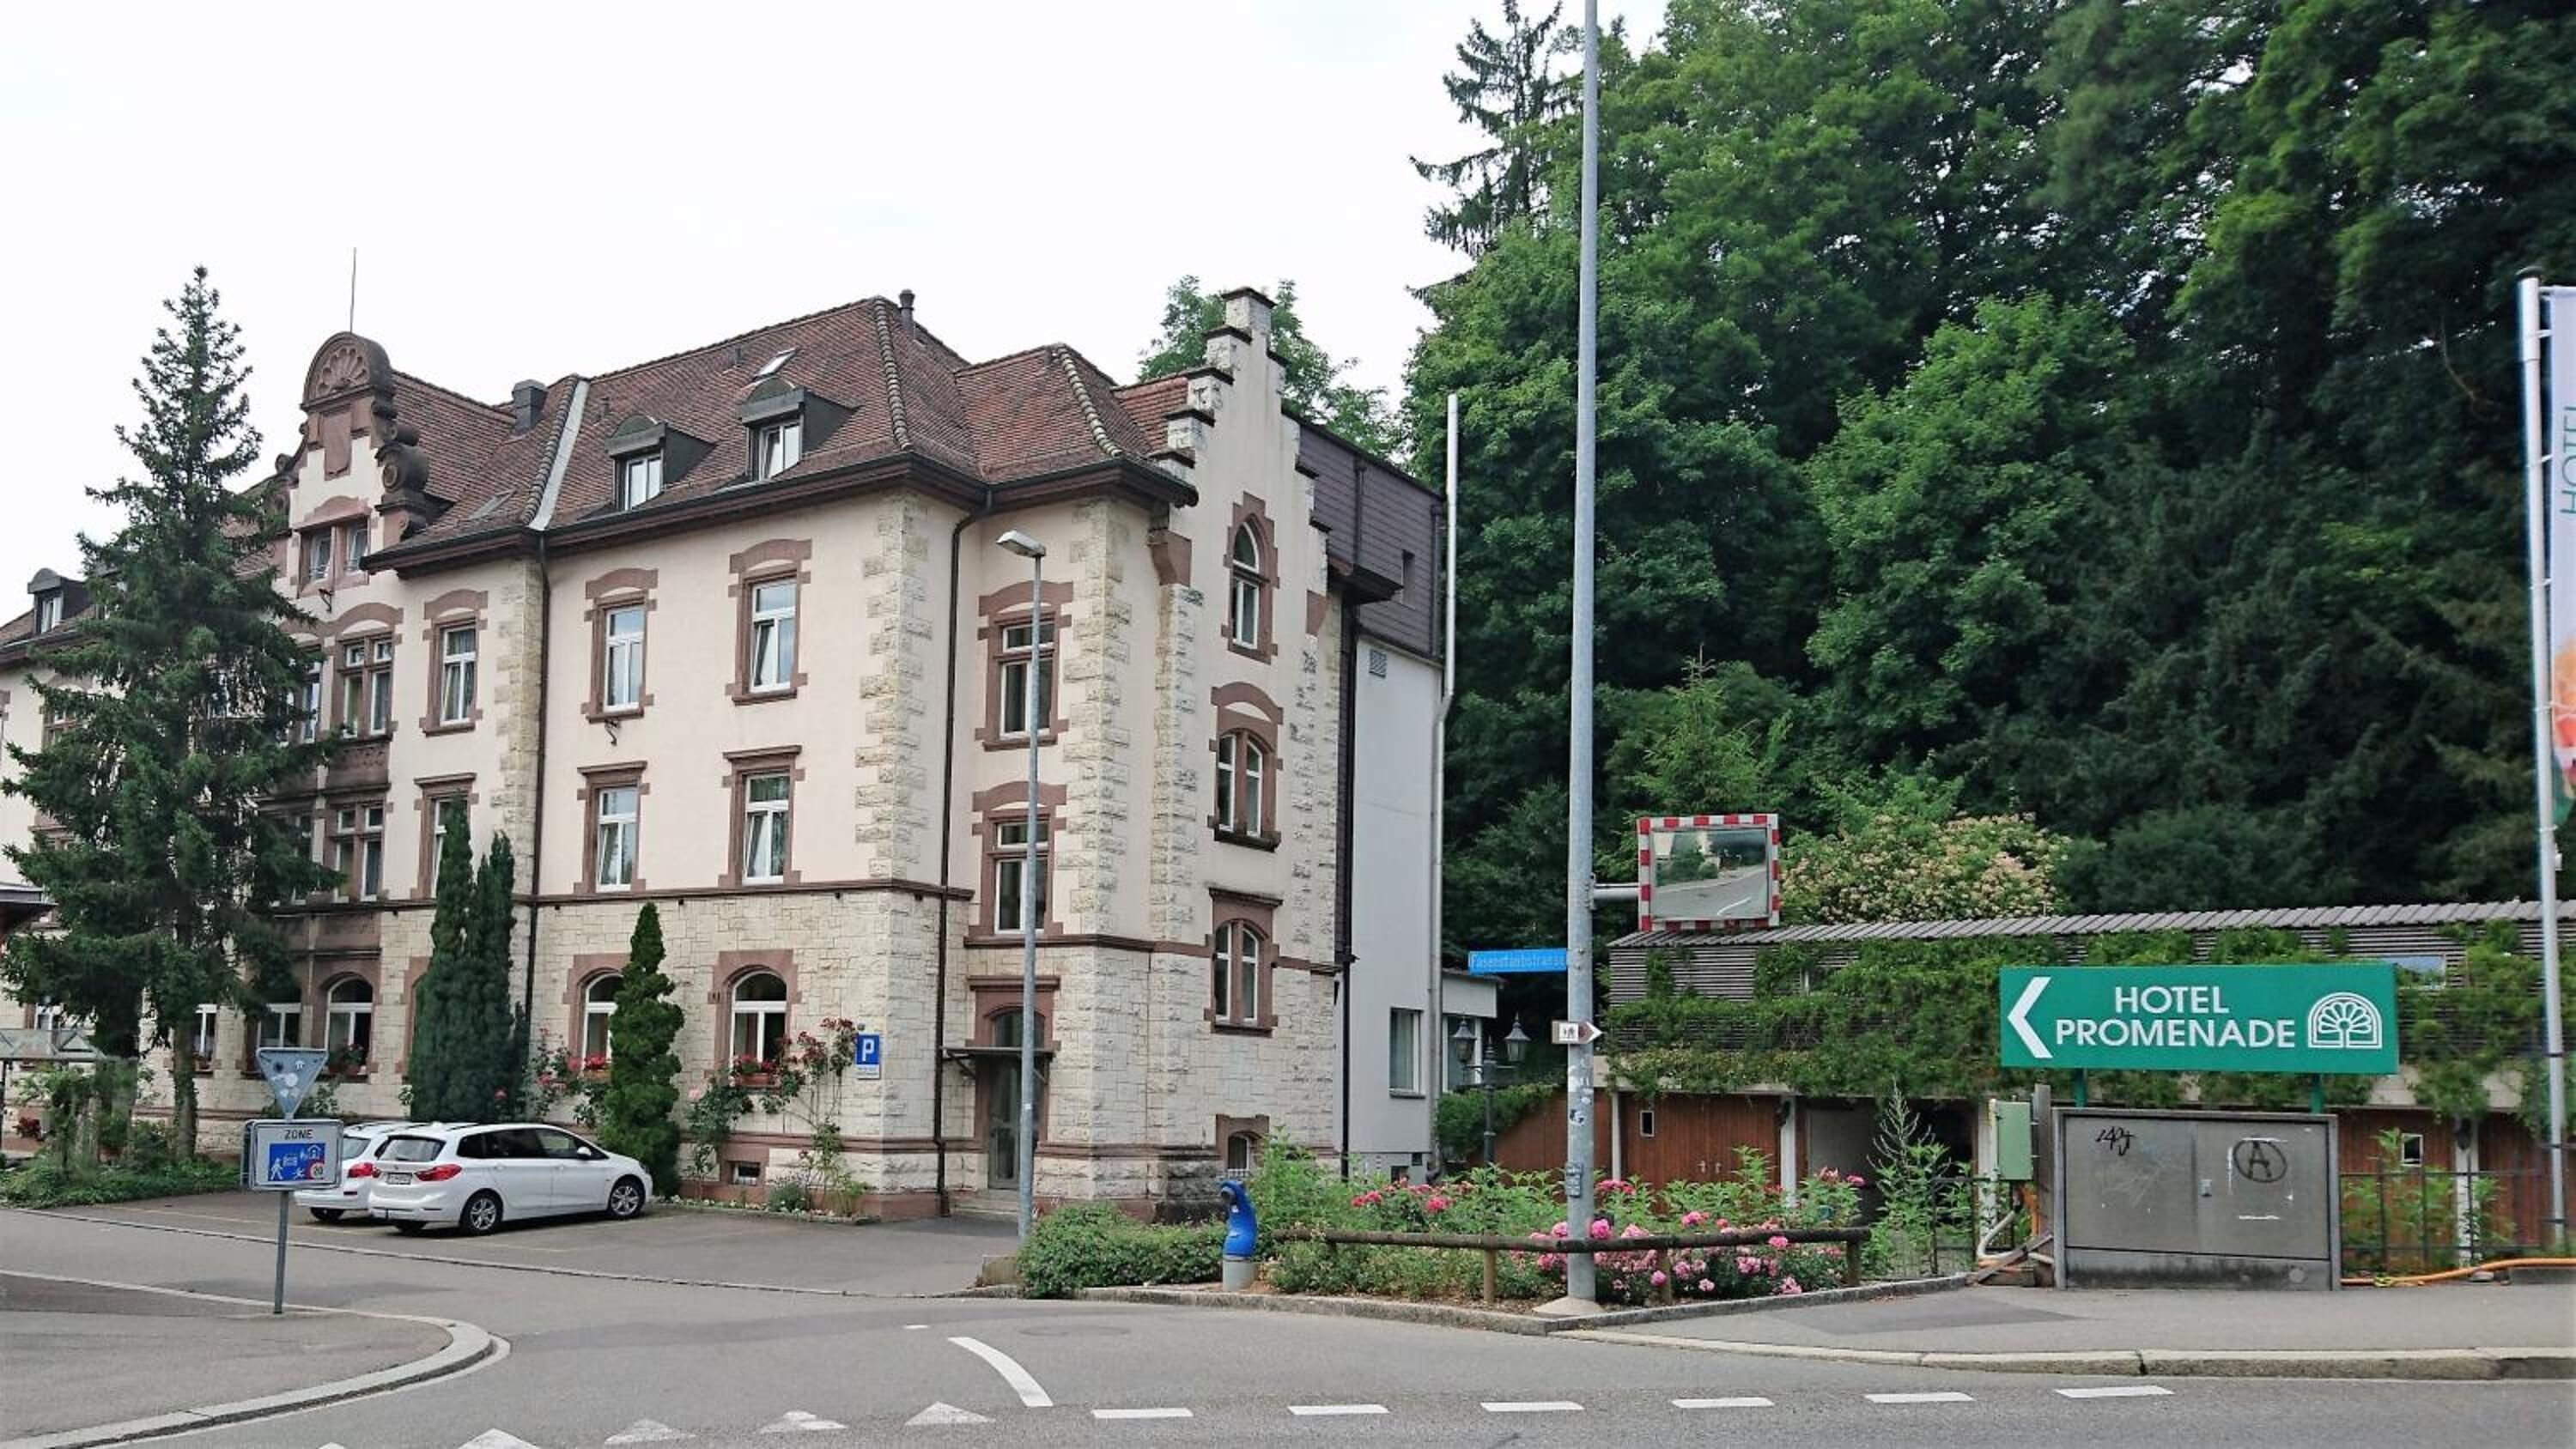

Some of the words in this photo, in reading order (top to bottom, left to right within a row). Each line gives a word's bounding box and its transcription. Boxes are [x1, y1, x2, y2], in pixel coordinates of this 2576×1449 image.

[2115, 985, 2229, 1014] HOTEL
[2057, 1019, 2295, 1047] PROMENADE
[862, 1040, 874, 1061] P
[284, 1129, 313, 1139] ZONE
